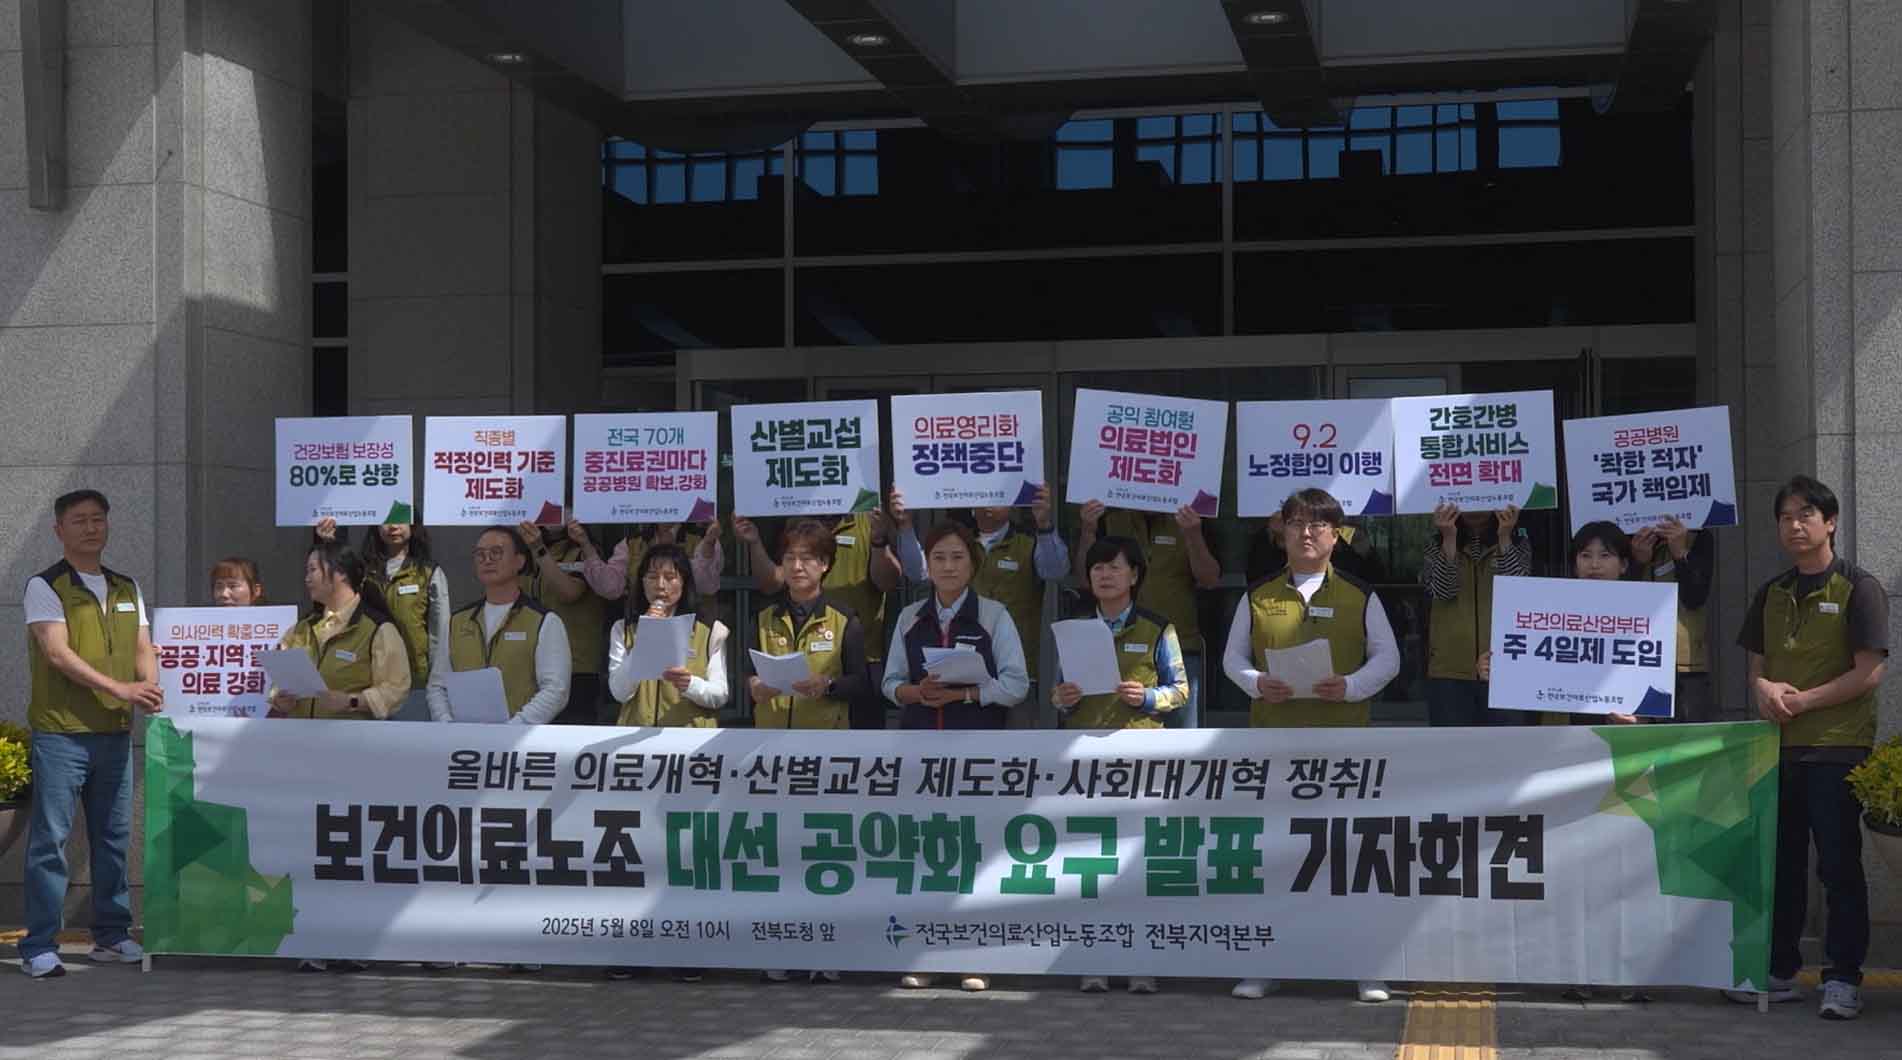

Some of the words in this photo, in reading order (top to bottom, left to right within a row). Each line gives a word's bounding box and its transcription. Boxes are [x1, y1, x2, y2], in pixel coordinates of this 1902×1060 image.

[915, 414, 1018, 440] 의료영리화
[1107, 404, 1140, 425] 공익
[1144, 407, 1195, 431] 참여형
[1430, 403, 1518, 431] 간호간병
[474, 430, 515, 447] 직종별
[607, 428, 639, 447] 전국
[643, 427, 684, 446] 70개
[750, 416, 861, 452] 산별교섭
[1099, 425, 1197, 459] 의료법인
[1293, 423, 1337, 449] 9.2
[1420, 432, 1529, 460] 통합서비스
[1614, 424, 1680, 448] 공공병원
[294, 443, 349, 461] 건강보험
[353, 442, 394, 460] 보장성
[434, 451, 512, 474] 적정인력
[517, 451, 555, 473] 기준
[585, 450, 707, 473] 중진료권마다
[912, 441, 1024, 475] 정책중단
[1248, 452, 1333, 477] 노정합의
[1339, 451, 1382, 476] 이행
[290, 464, 356, 487] 80%로
[362, 463, 400, 486] 상향
[584, 475, 641, 493] 공공병원
[766, 455, 849, 488] 제도화
[1108, 456, 1182, 487] 제도화
[1429, 462, 1472, 487] 전면
[1478, 459, 1522, 484] 확대
[465, 477, 524, 500] 제도화
[1592, 480, 1637, 506] 국가
[1642, 473, 1712, 501] 책임제
[171, 624, 224, 641] 의사인력
[1515, 610, 1650, 635] 보건의료산업부터
[1503, 634, 1527, 661] 주
[1534, 635, 1605, 665] 4일제
[1611, 638, 1663, 668] 도입
[182, 671, 221, 695] 의료
[227, 671, 266, 696] 강화
[447, 749, 557, 792] 올바른
[570, 751, 903, 797] 의료개혁·산별교섭
[915, 756, 1271, 801] 제도화·사회대개혁
[1285, 758, 1387, 801] 쟁취!
[314, 803, 646, 888] 보건의료노조
[665, 810, 781, 893] 대선
[800, 811, 983, 897] 공약화
[1000, 813, 1119, 899] 요구
[1144, 815, 1265, 897] 발표
[1289, 813, 1545, 901] 기자회견
[541, 917, 595, 938] 2025년
[600, 918, 626, 939] 5월
[629, 918, 656, 939] 8일
[659, 919, 691, 941] 오전
[696, 919, 732, 942] 10시
[750, 919, 815, 942] 전북도청
[820, 920, 837, 943] 앞
[915, 921, 1136, 950] 전국보건의료산업노동조합
[1144, 922, 1276, 952] 전북지역본부
